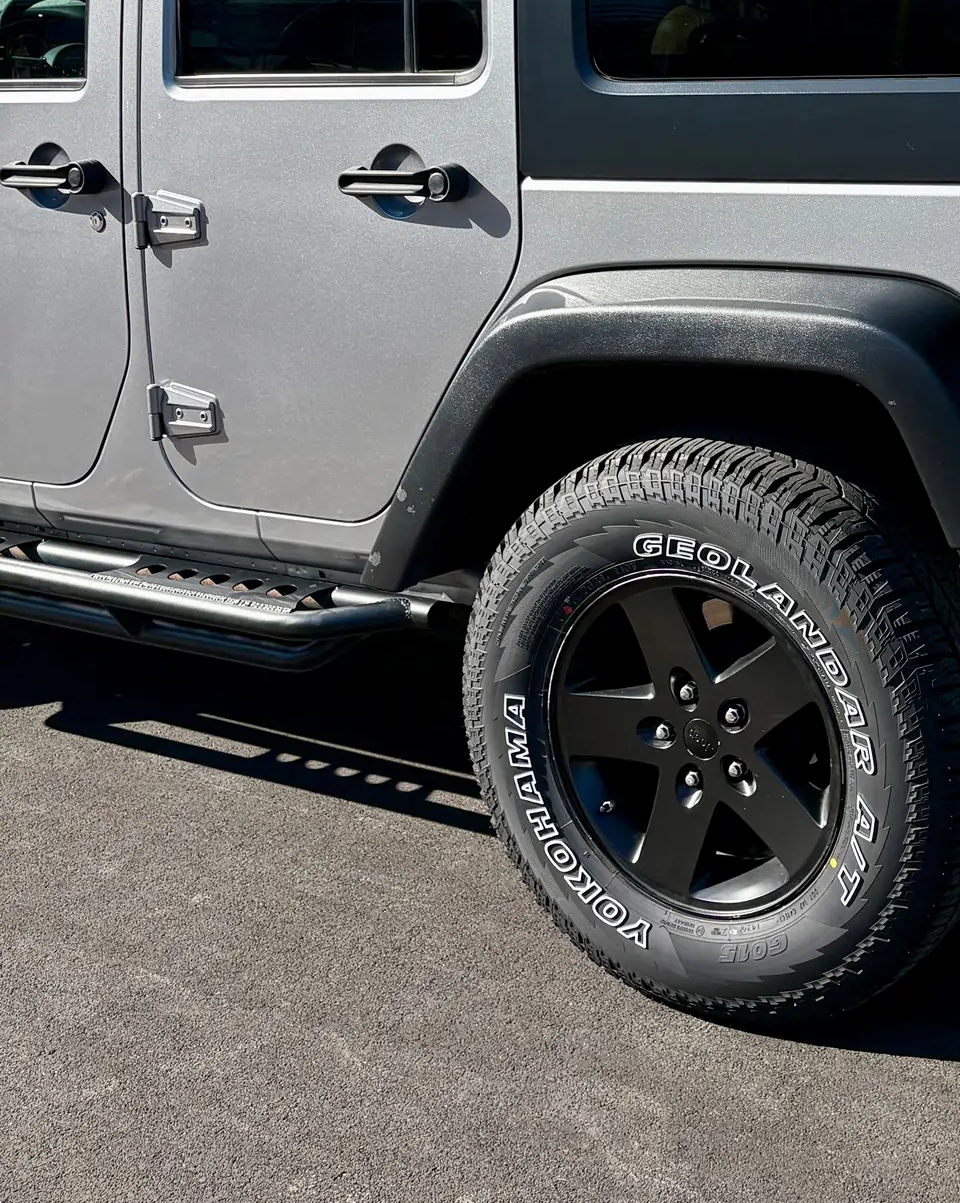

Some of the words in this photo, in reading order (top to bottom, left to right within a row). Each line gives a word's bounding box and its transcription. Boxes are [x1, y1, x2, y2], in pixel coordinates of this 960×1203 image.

[503, 694, 653, 949] YOKOHAMA
[632, 533, 878, 776] GEOLANDAR
[839, 793, 877, 906] A/T
[719, 933, 789, 964] G015
